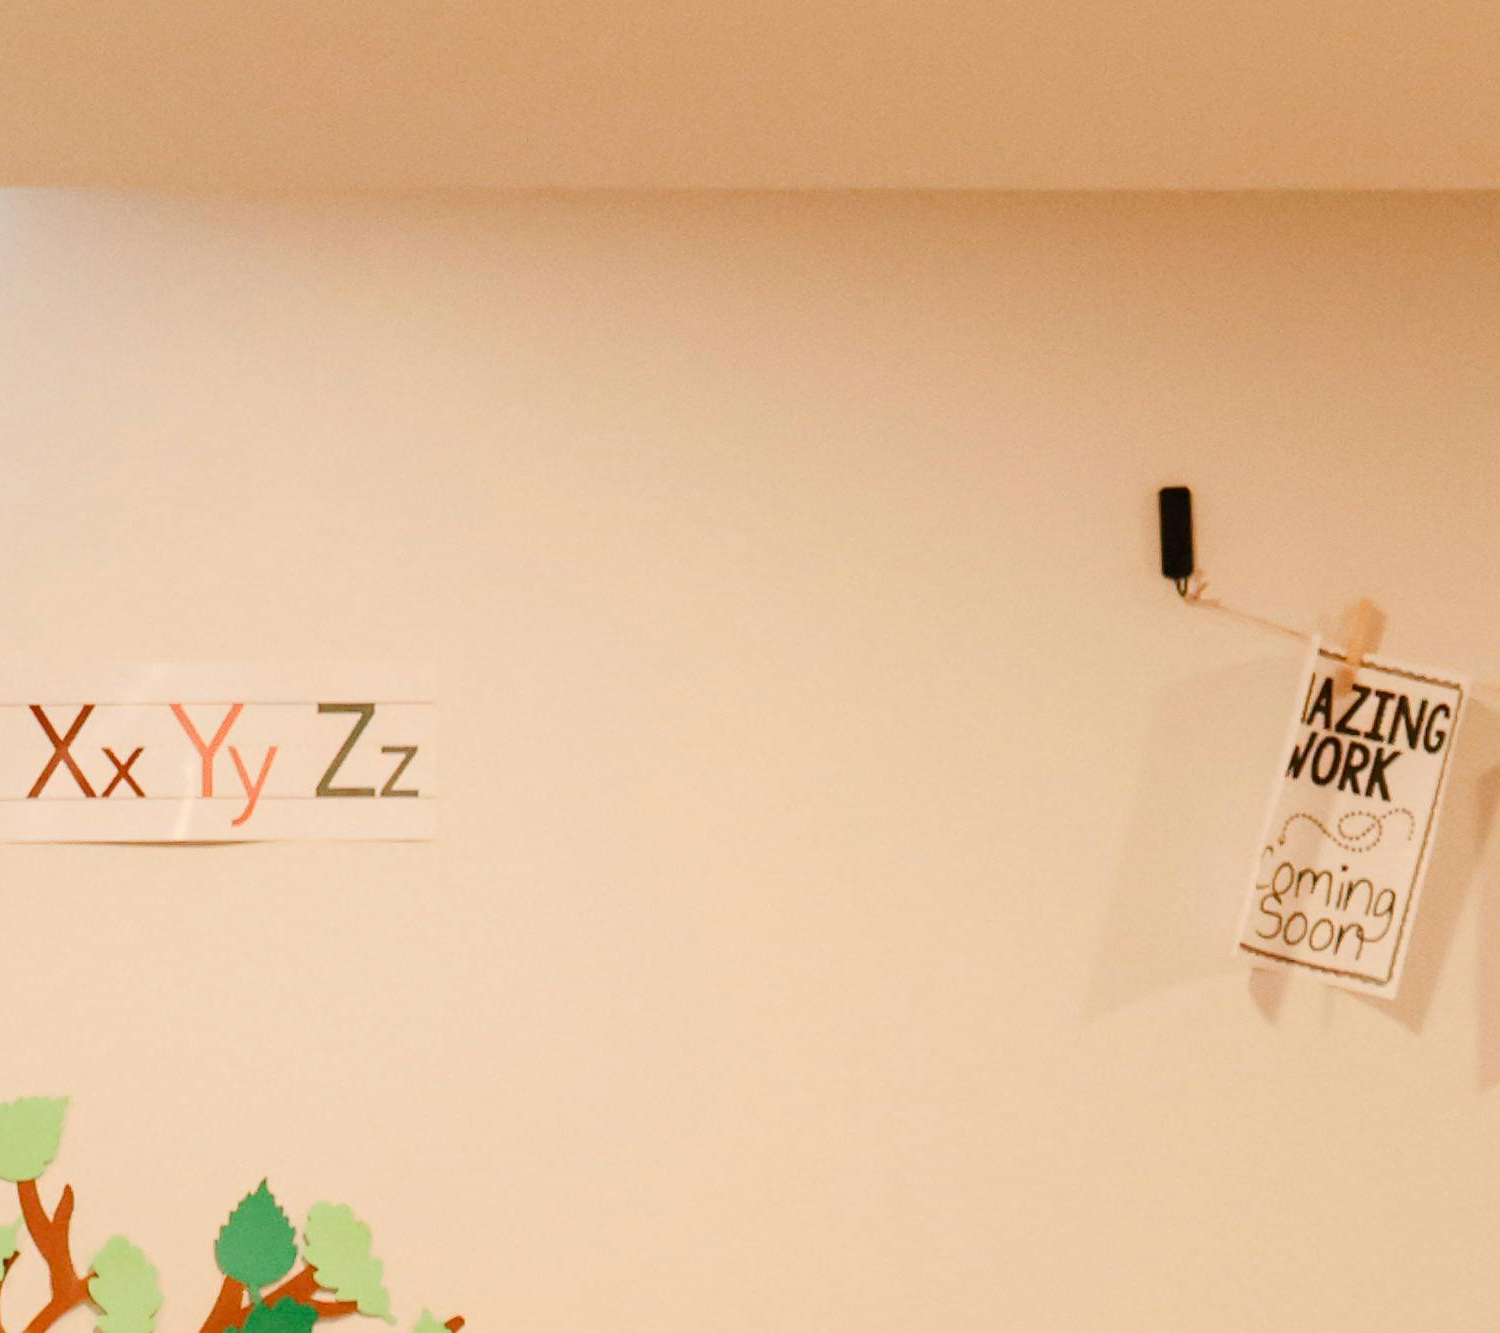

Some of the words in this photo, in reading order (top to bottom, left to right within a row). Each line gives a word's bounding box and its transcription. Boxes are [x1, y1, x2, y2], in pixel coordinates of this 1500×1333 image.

[26, 704, 146, 799] Xx
[170, 704, 277, 826] Yy
[315, 703, 420, 798] Zz
[1305, 677, 1451, 754] AZING
